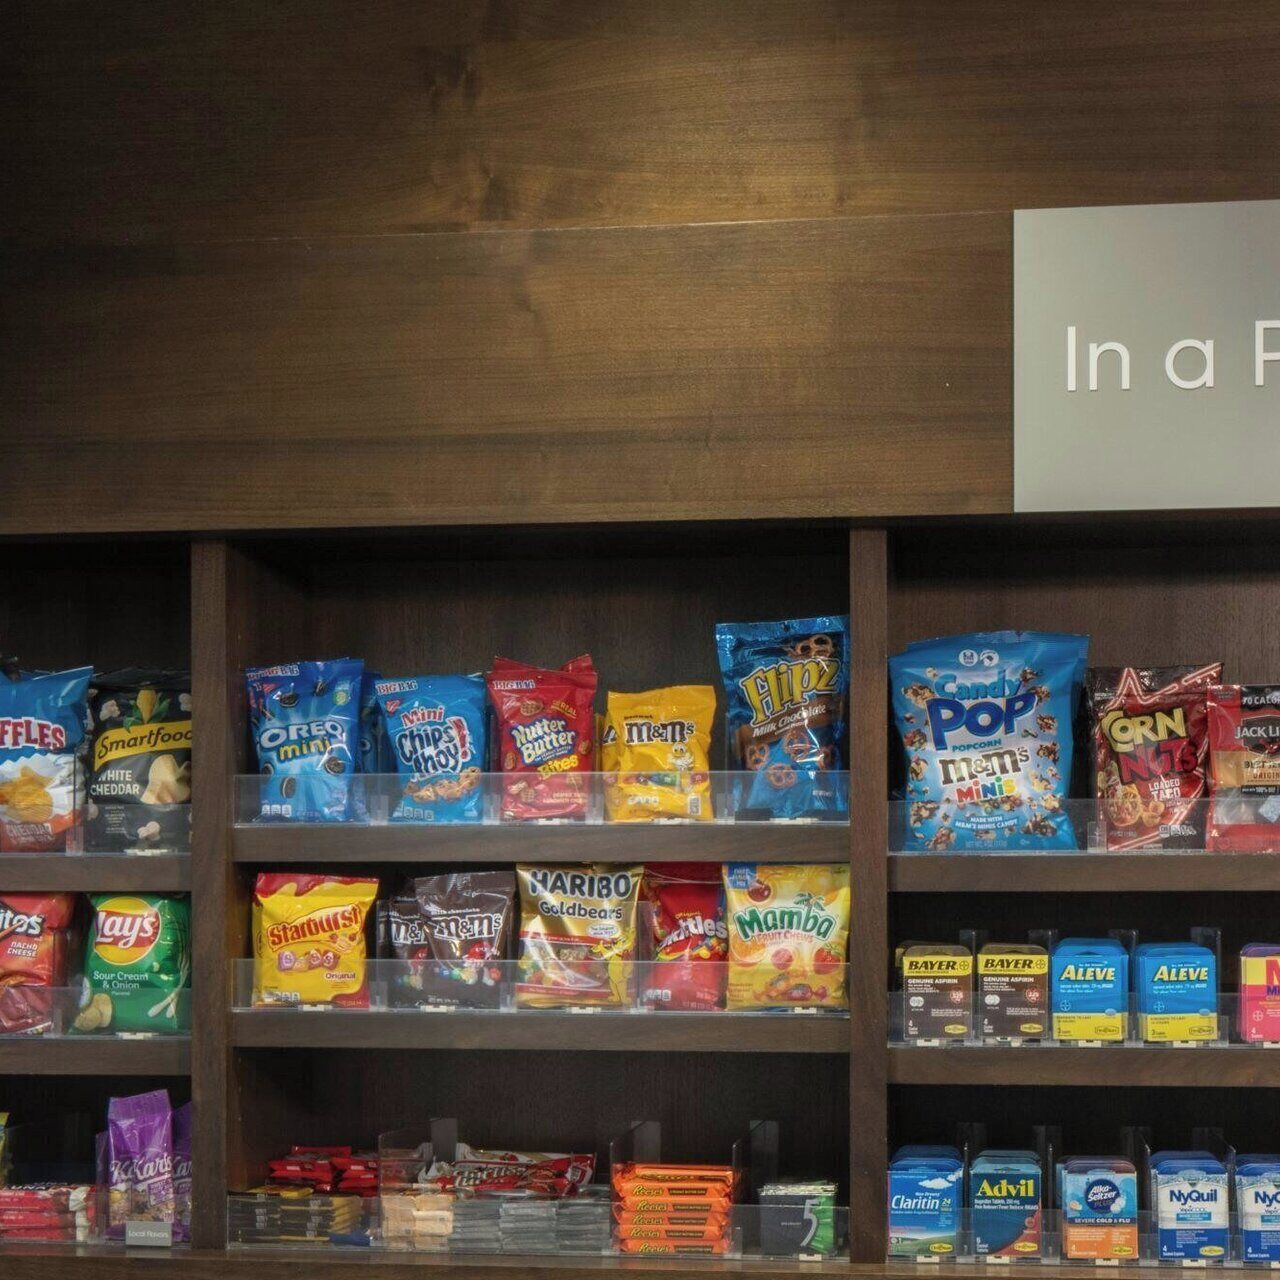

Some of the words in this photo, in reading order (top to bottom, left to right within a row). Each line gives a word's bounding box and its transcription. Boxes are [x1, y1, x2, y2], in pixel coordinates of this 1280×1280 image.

[1066, 325, 1131, 392] In
[1164, 338, 1215, 390] a
[743, 657, 841, 727] Flipz
[933, 670, 1022, 701] Candy
[401, 705, 445, 729] Mini
[926, 692, 1038, 751] POP
[259, 720, 345, 750] OREO
[396, 720, 455, 760] Chips
[511, 718, 567, 748] Nutter
[752, 722, 778, 739] Milk
[1102, 707, 1187, 753] CORN
[1235, 726, 1266, 739] JACK
[277, 738, 332, 762] mini
[522, 731, 577, 764] Butter
[951, 738, 1002, 753] POPCORN
[537, 754, 580, 780] Bites
[1119, 738, 1199, 786] NUTS
[90, 783, 140, 797] CHEDDAR
[528, 870, 633, 899] HARIBO
[540, 901, 623, 920] Goldbears
[95, 911, 159, 949] Lay's
[269, 904, 362, 949] Starburst
[734, 906, 837, 943] Mamba
[93, 970, 115, 981] Sour
[117, 970, 149, 981] Cream
[907, 960, 959, 971] BAYER
[983, 958, 1034, 969] BAYER
[1060, 964, 1116, 981] ALEVE
[1153, 965, 1209, 982] ALEVE
[102, 980, 110, 990] &
[111, 979, 140, 990] Onion
[976, 1178, 1035, 1197] Advil
[1087, 1191, 1116, 1202] Seltzer
[1090, 1185, 1112, 1193] Alka-
[1169, 1189, 1218, 1206] NyQuil
[891, 1194, 940, 1210] Claritin
[800, 1198, 820, 1248] 5
